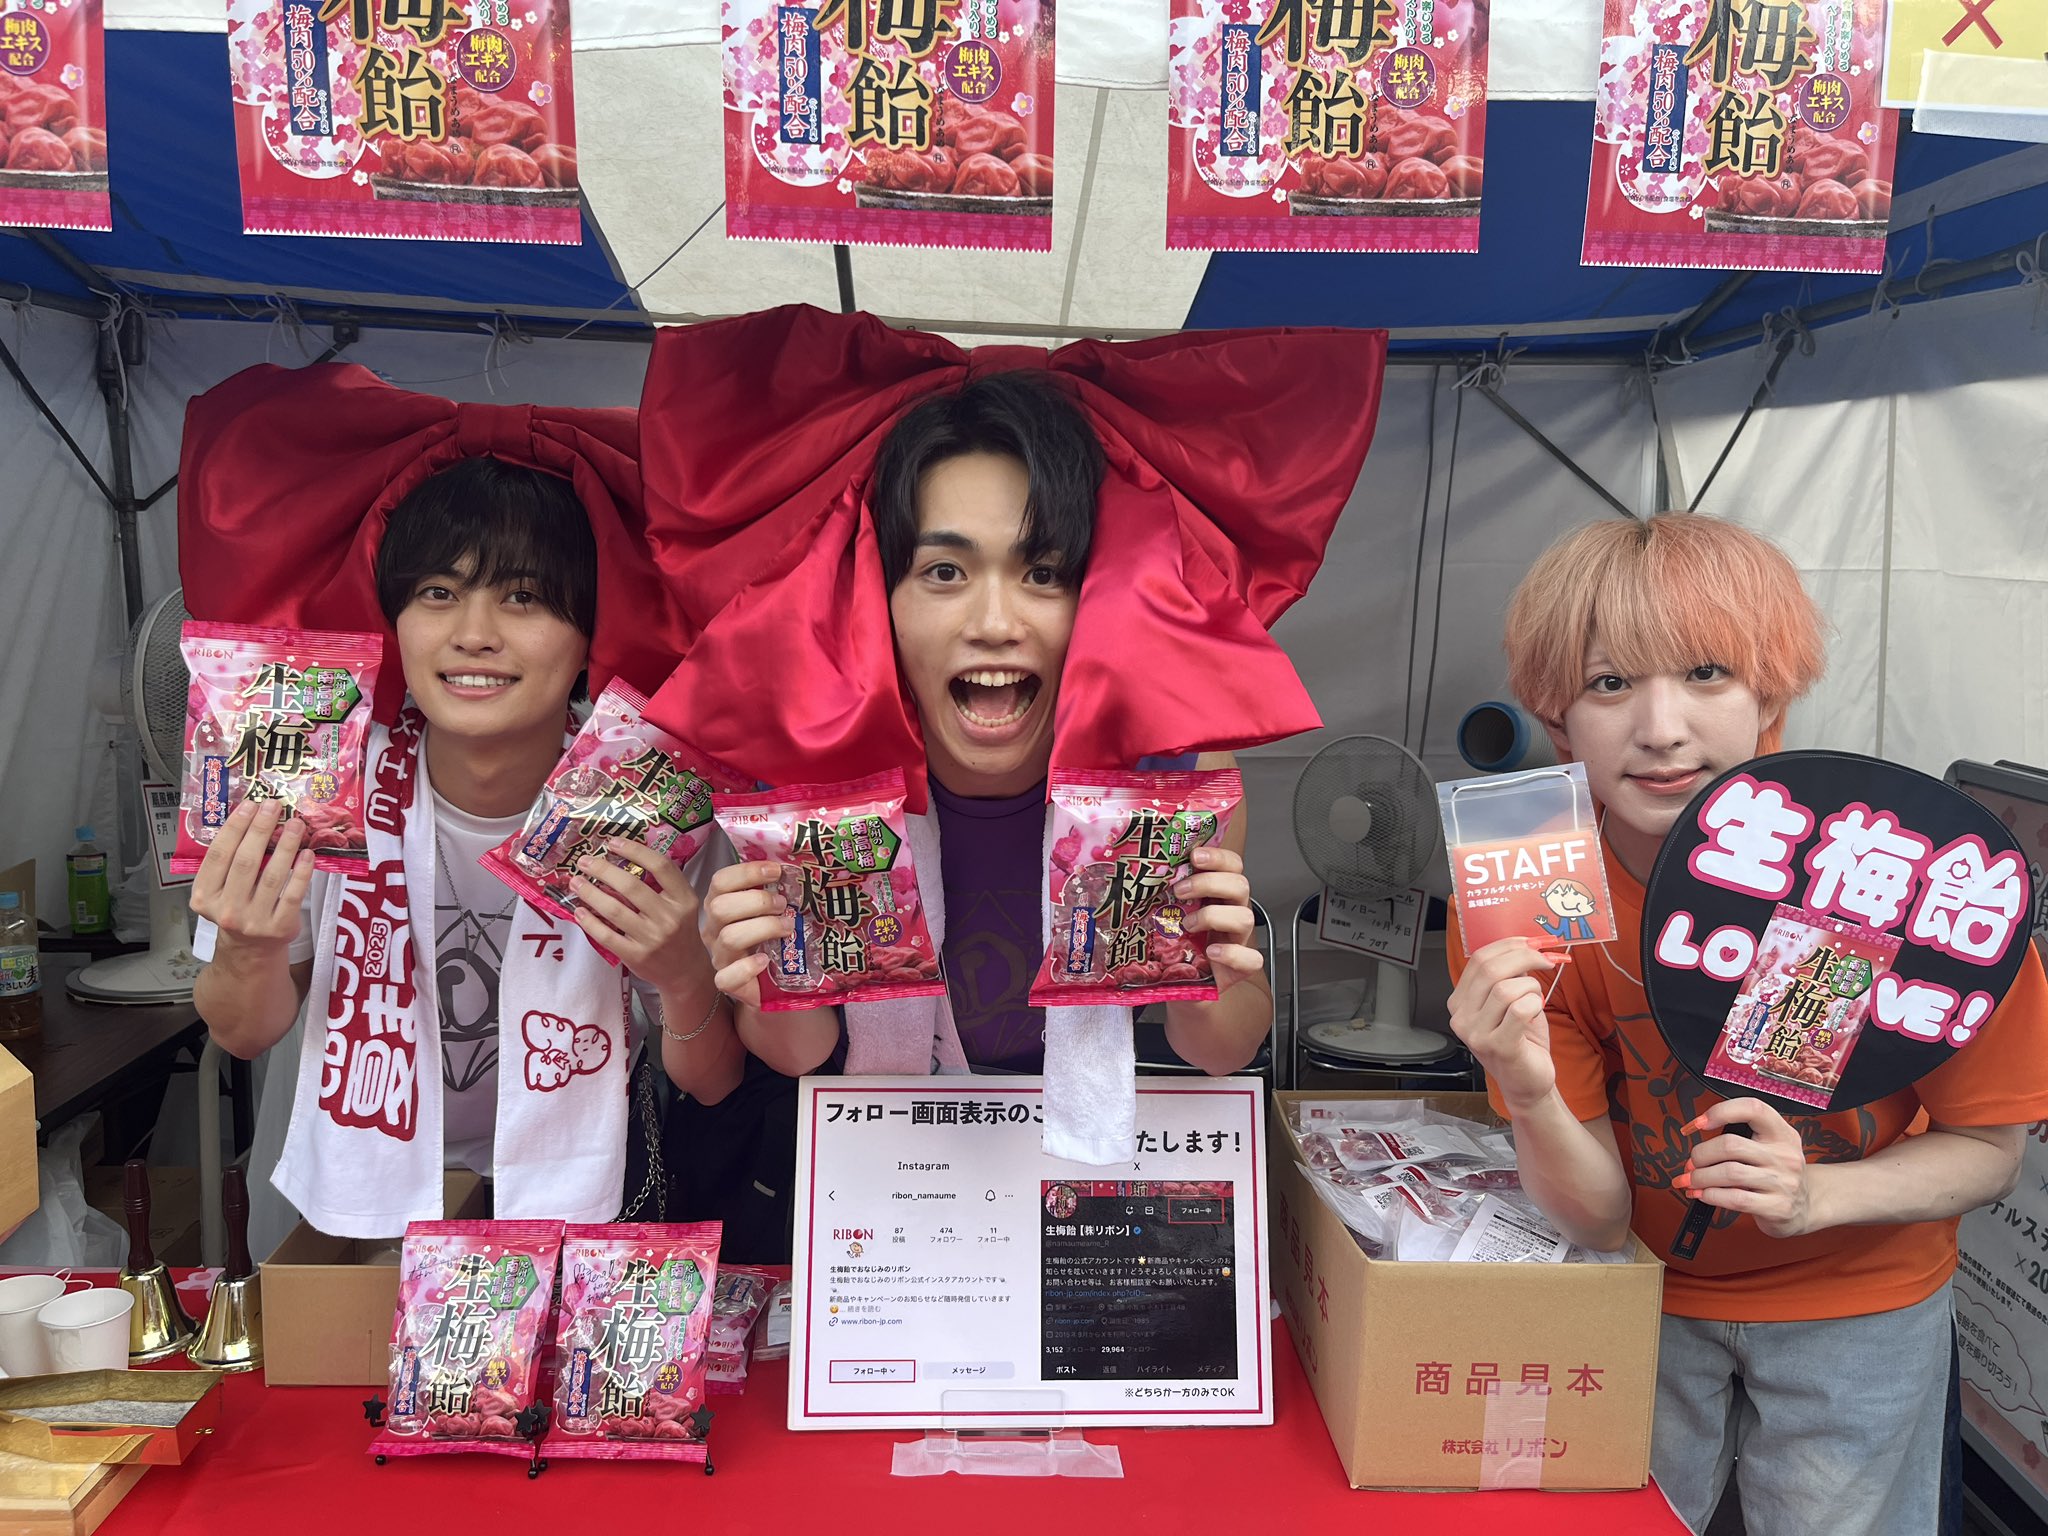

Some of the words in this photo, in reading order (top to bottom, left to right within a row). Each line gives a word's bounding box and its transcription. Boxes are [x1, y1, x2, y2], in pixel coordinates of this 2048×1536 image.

[5, 18, 37, 35] 梅肉
[0, 36, 43, 53] エキス
[470, 35, 503, 53] 梅肉
[9, 53, 35, 66] 配合
[465, 53, 509, 69] エキス
[957, 47, 990, 65] 梅肉
[1393, 53, 1426, 70] 梅肉
[285, 5, 321, 131] 梅肉50%配合
[475, 69, 501, 83] 配合
[781, 12, 811, 138] 梅肉50%配合
[951, 64, 996, 81] エキス
[1387, 70, 1430, 86] エキス
[961, 81, 988, 95] 配合
[1224, 30, 1251, 150] 梅肉50%配合
[1395, 86, 1422, 100] 配合
[1811, 79, 1842, 96] 梅肉
[1647, 49, 1677, 168] 梅肉50%配合
[1805, 95, 1845, 111] エキス
[1812, 110, 1836, 124] 配合
[193, 647, 235, 660] RIBON
[1065, 795, 1102, 807] RIBON
[731, 812, 768, 825] RIBON
[868, 820, 884, 845] 紀州の
[840, 839, 855, 861] 使用
[850, 818, 876, 868] 南高梅
[1169, 832, 1183, 856] 使用
[1463, 839, 1586, 885] STAFF
[1692, 777, 2024, 962] 生梅飴
[793, 820, 877, 973] 生梅飴
[1094, 808, 1173, 971] 生梅飴
[1466, 880, 1545, 898] カラフルダイヤモンド
[873, 925, 899, 936] エキス
[1776, 928, 1804, 942] RIBON
[365, 922, 389, 977] 2025
[1763, 945, 1840, 1061] 生梅飴
[897, 1160, 951, 1172] Instagram
[1133, 1162, 1141, 1171] X
[891, 1191, 957, 1201] ribon_namaume
[833, 1228, 874, 1241] RIBON
[939, 1227, 953, 1235] 474
[989, 1227, 998, 1235] 11
[575, 1248, 606, 1258] RIBON
[829, 1265, 912, 1273] 生梅飴でおなじみのリボン
[841, 1317, 903, 1326] www.ribon-jp.com
[419, 1254, 497, 1416] 生梅飴
[589, 1259, 667, 1418] 生梅飴
[1045, 1346, 1064, 1354] 3,152
[1101, 1346, 1125, 1354] 29,964
[853, 1367, 888, 1375] フォロー中
[952, 1366, 986, 1374] メッセージ
[1055, 1366, 1078, 1374] ポスト
[1415, 1360, 1605, 1397] 商品見本
[1441, 1438, 1499, 1456] 株式会社
[1505, 1437, 1569, 1459] リボン
